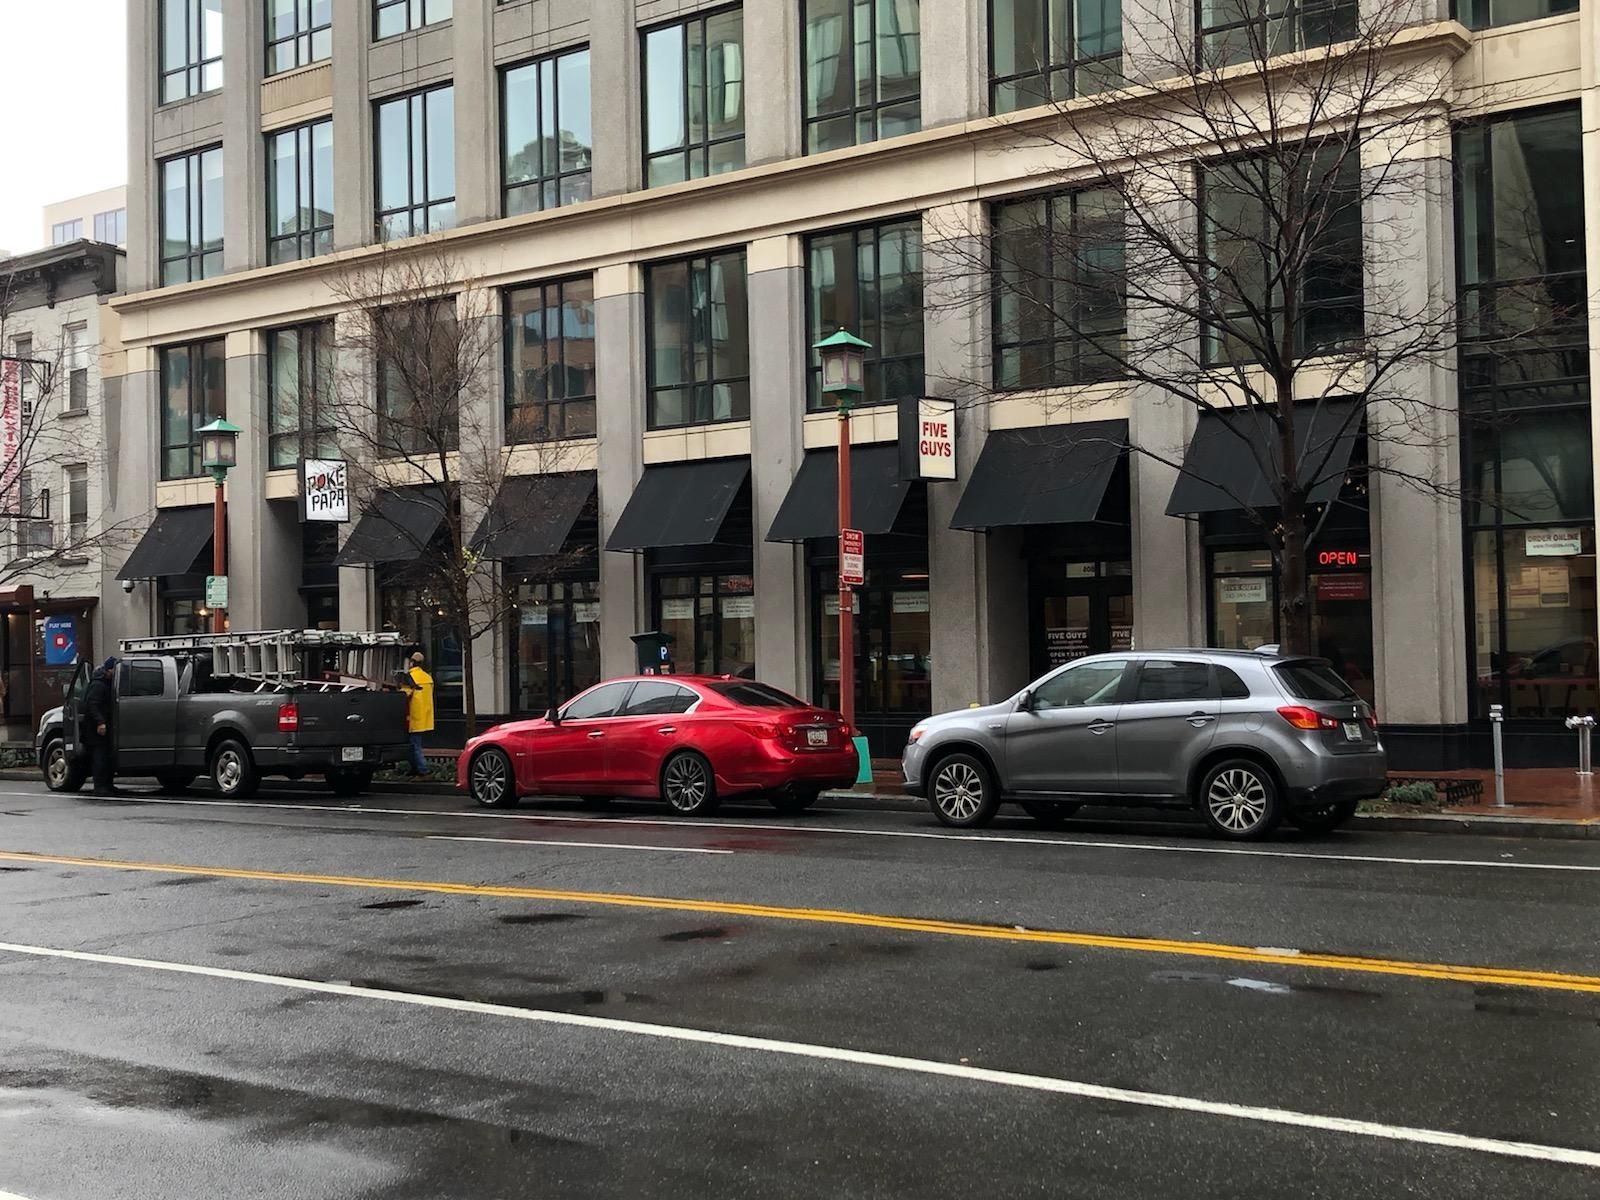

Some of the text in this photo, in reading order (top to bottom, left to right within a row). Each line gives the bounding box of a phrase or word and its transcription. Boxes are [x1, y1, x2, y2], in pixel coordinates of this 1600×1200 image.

[922, 421, 948, 438] FIVE
[920, 440, 951, 457] GUYS
[312, 489, 345, 512] PAPA
[1319, 552, 1356, 565] OPEN
[1066, 631, 1087, 639] GUYS
[1112, 630, 1130, 638] FIVE
[660, 646, 668, 660] P
